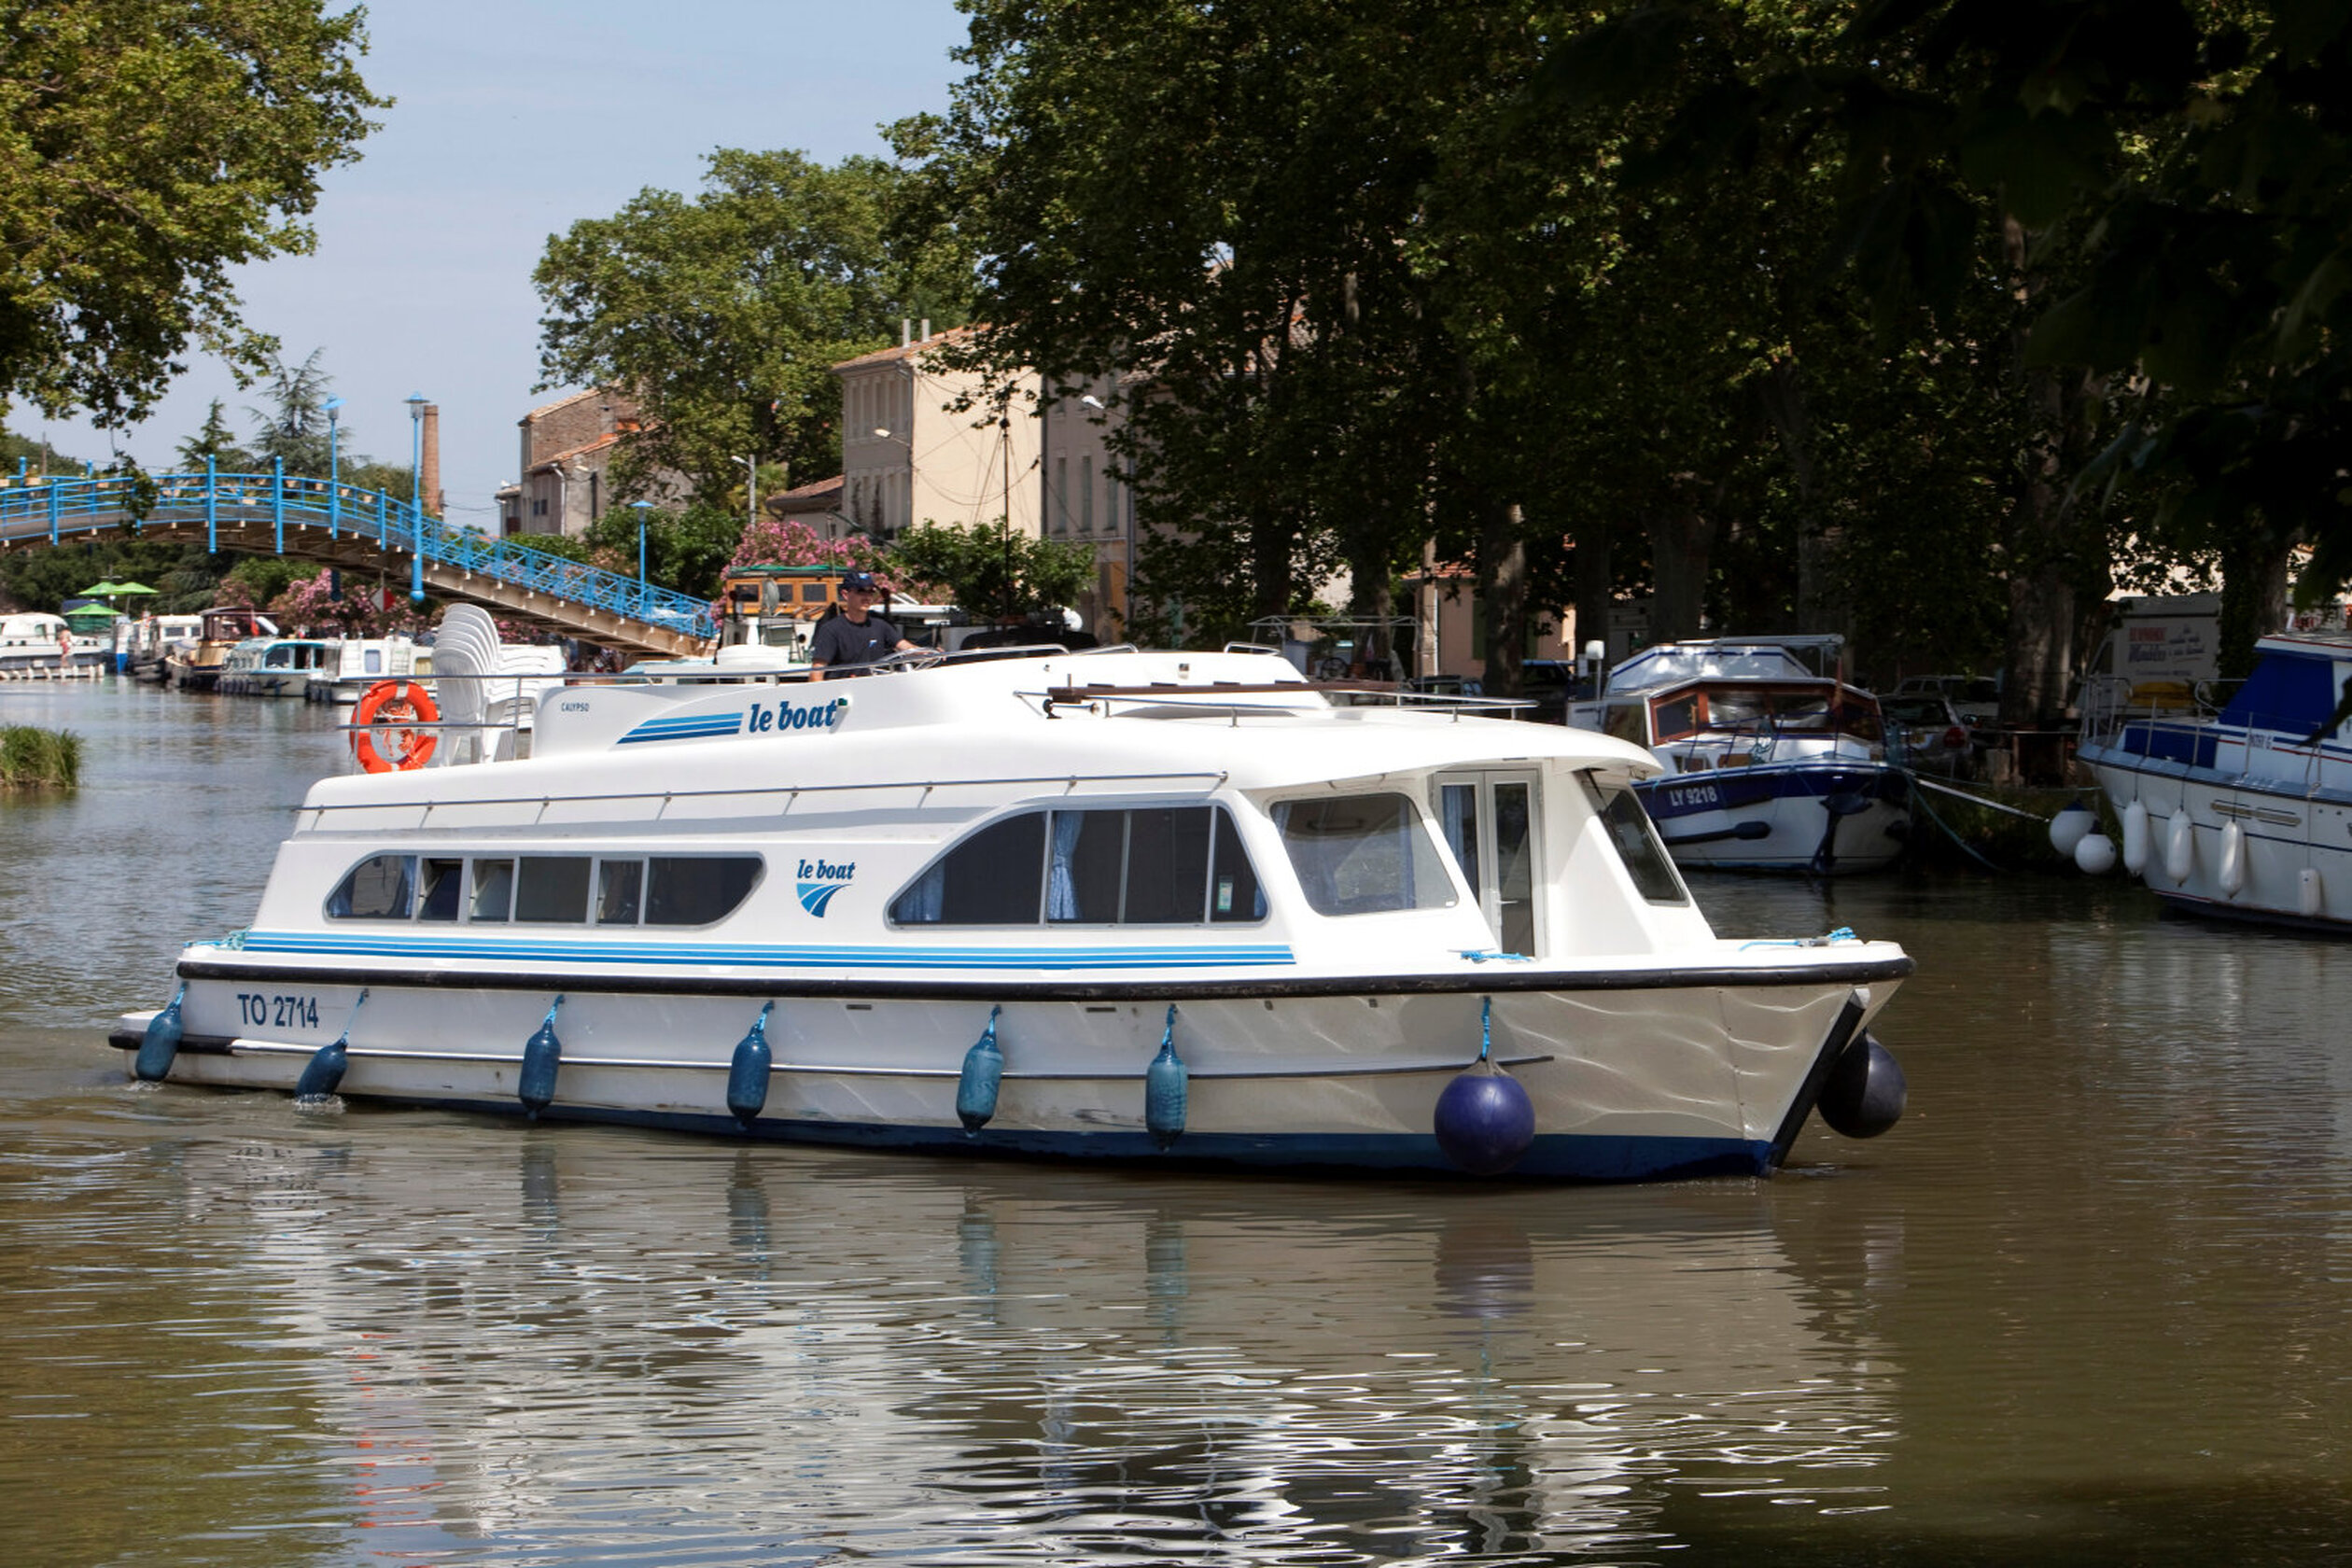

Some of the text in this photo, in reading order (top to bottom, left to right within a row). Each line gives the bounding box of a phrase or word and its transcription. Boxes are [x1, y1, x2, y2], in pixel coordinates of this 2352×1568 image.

[561, 702, 590, 712] CALYPSO
[749, 699, 838, 733] le boat
[1669, 785, 1718, 807] LY 9218
[797, 859, 856, 880] le boat
[237, 993, 319, 1029] TO 2714
